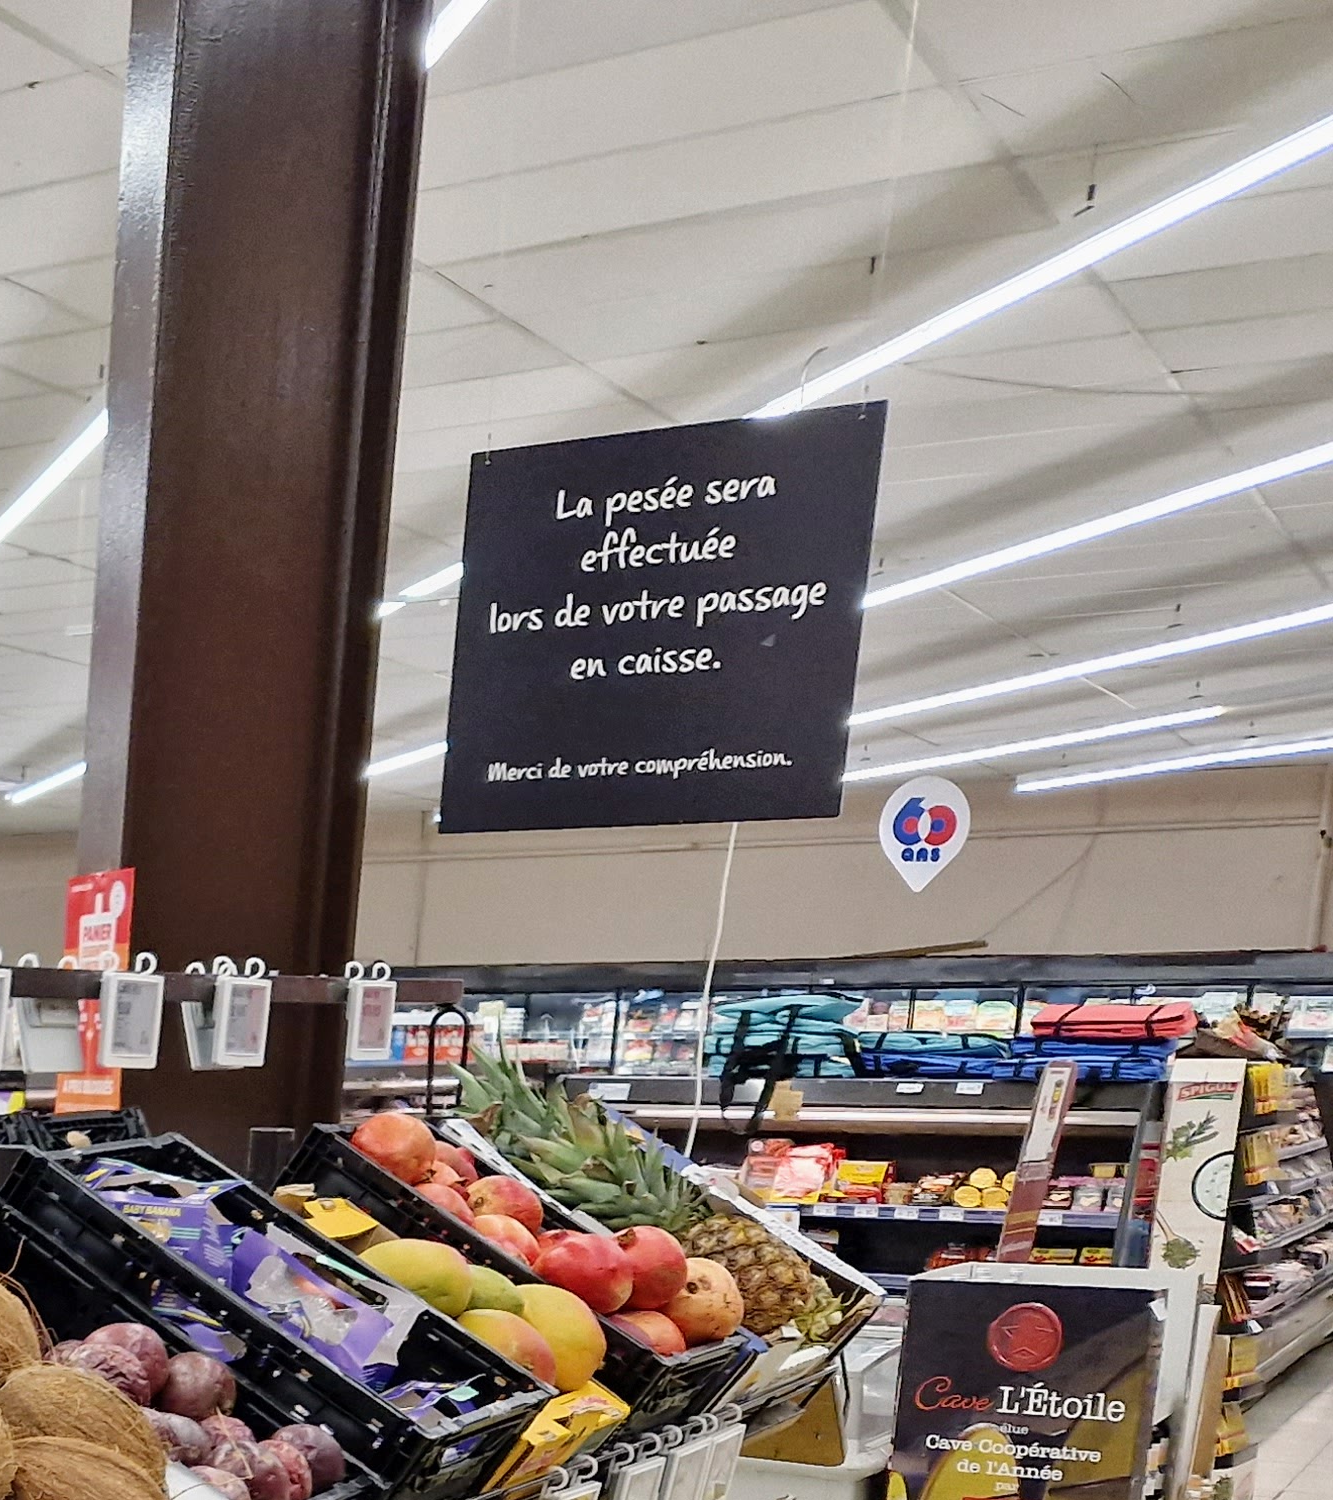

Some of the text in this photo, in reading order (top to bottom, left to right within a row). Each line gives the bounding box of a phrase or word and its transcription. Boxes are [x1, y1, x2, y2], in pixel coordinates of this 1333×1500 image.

[556, 471, 777, 525] La pesée sera
[580, 528, 736, 573] effectuée
[490, 579, 827, 634] lors de votre passage
[570, 645, 721, 680] en caisse.
[488, 748, 792, 783] Merci de votre compréhension.
[893, 796, 958, 846] 60
[914, 1375, 1126, 1422] Cave L'Étoile
[925, 1433, 1102, 1463] Cave Coopérative
[999, 1422, 1029, 1436] élue
[956, 1459, 1063, 1482] de l'Année
